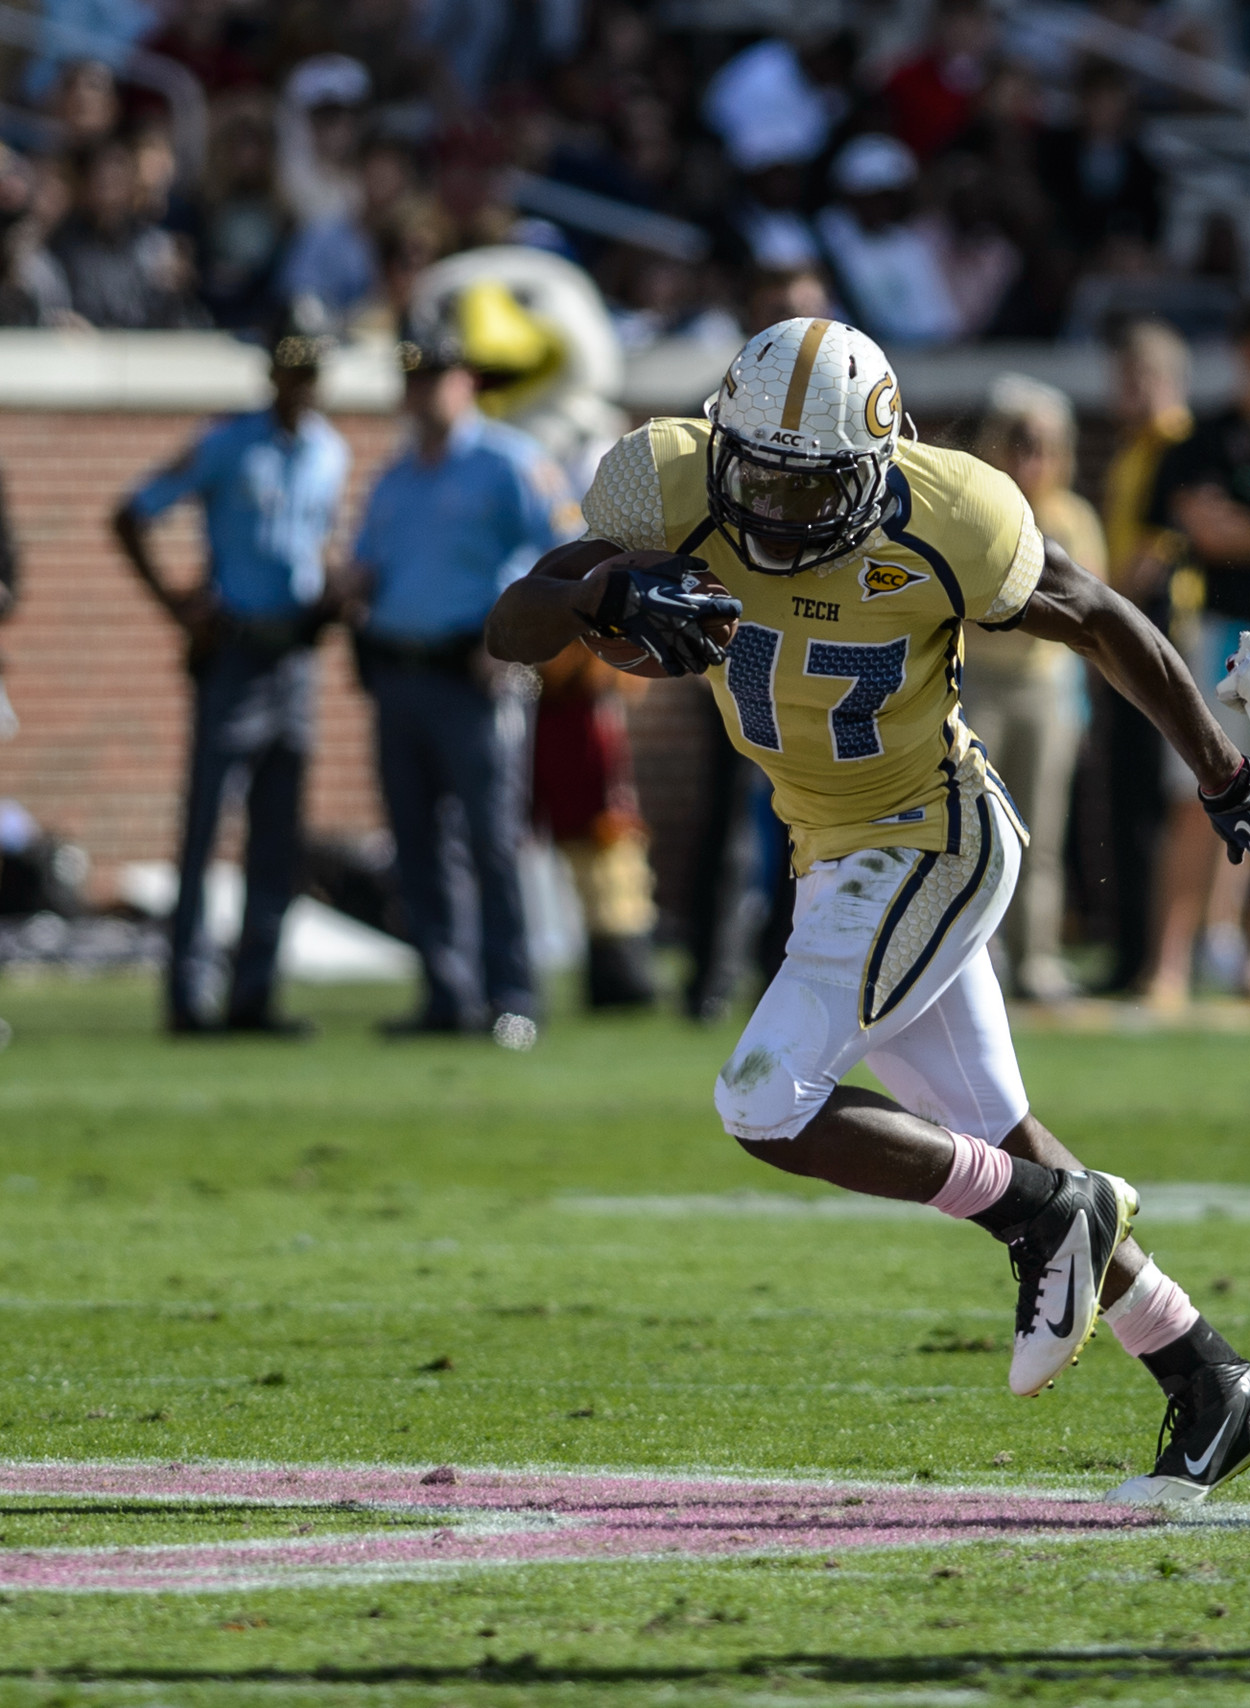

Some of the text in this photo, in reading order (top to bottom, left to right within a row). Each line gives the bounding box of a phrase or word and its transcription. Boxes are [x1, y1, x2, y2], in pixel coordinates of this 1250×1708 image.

[769, 431, 804, 447] ACC
[867, 570, 903, 587] ACC
[791, 596, 841, 622] TECH
[724, 621, 911, 762] 17
